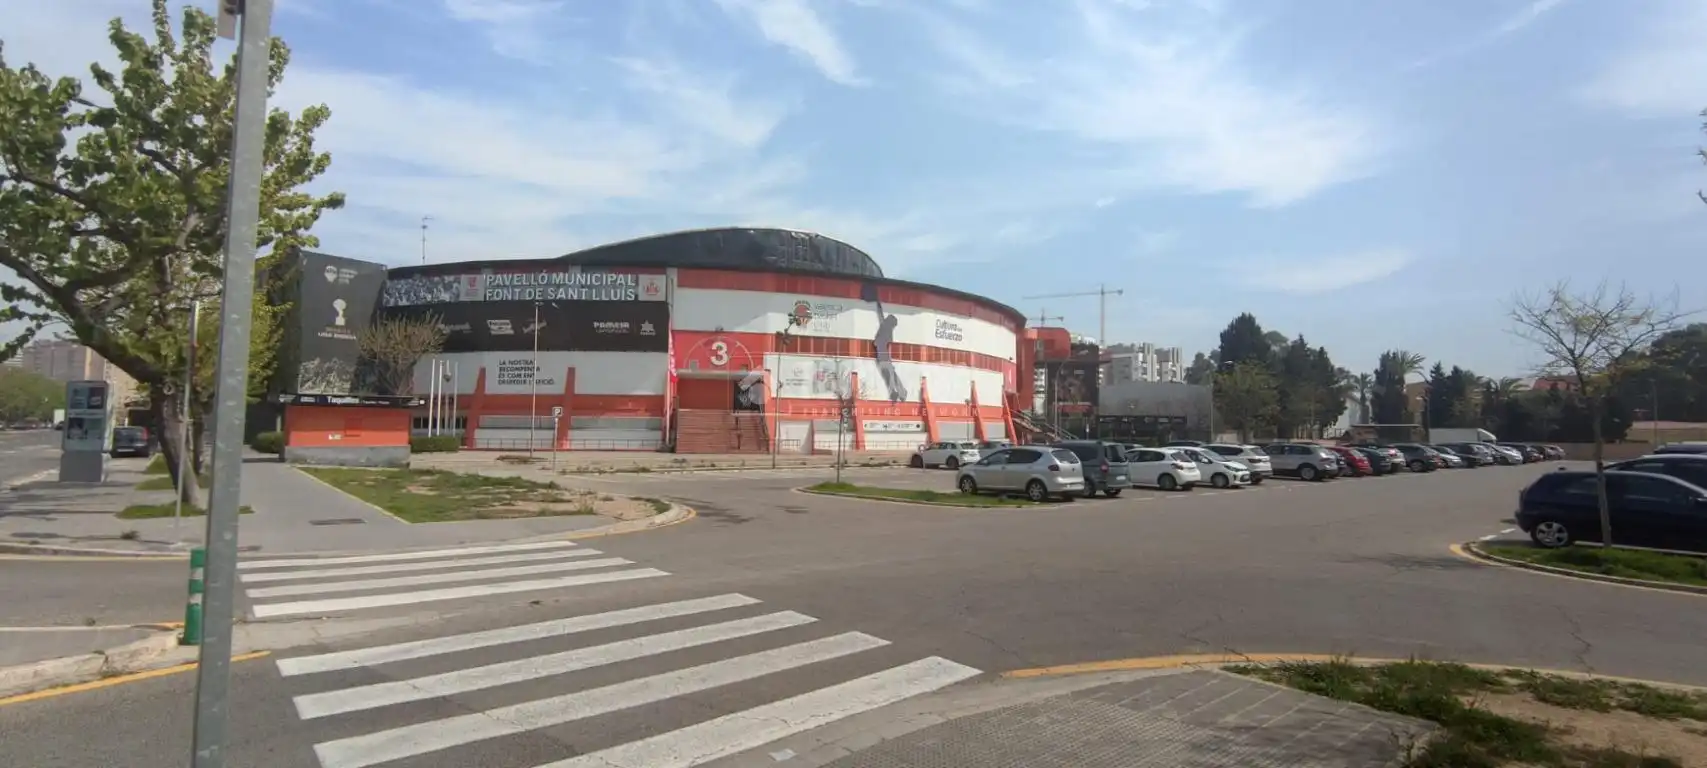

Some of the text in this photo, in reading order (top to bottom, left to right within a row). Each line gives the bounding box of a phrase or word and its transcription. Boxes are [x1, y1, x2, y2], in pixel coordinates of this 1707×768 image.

[487, 270, 636, 286] PAVELLÓ MUNICIPAL
[486, 289, 521, 301] FONT
[526, 288, 544, 300] DE
[547, 287, 588, 300] SANT
[592, 288, 635, 301] LLUÍS
[711, 341, 729, 366] 3
